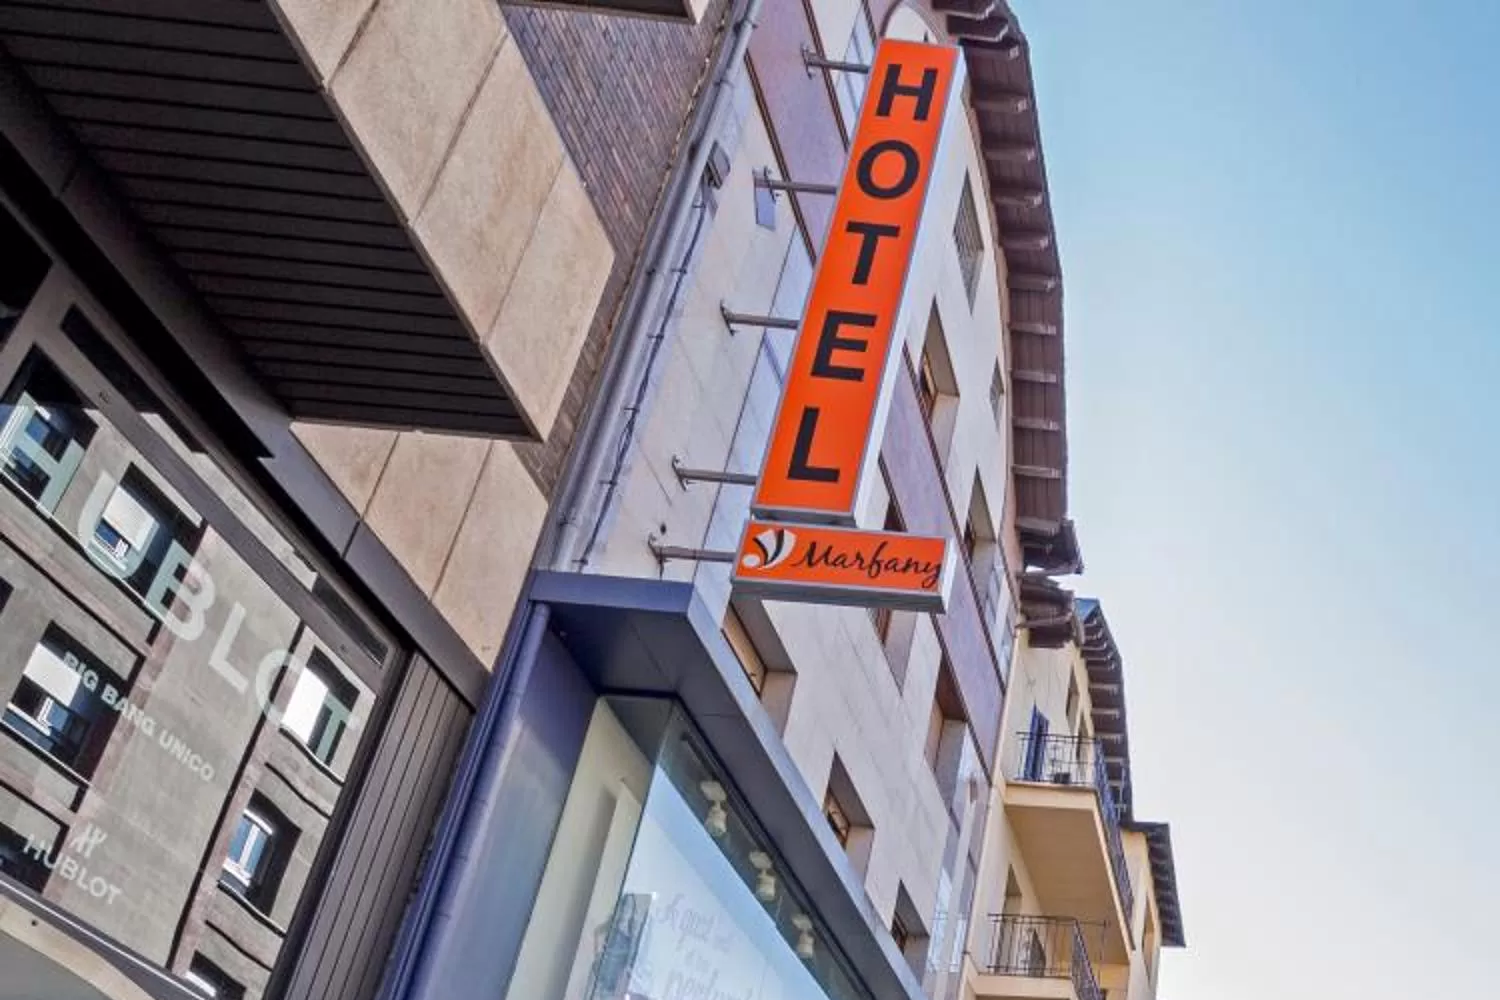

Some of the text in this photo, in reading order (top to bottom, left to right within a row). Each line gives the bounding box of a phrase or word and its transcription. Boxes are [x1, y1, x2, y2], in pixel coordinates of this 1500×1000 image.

[787, 63, 939, 484] HOTEL
[795, 540, 942, 588] Marfany
[62, 651, 216, 782] BIG BANG UNICO
[23, 833, 121, 905] HUBLOT
